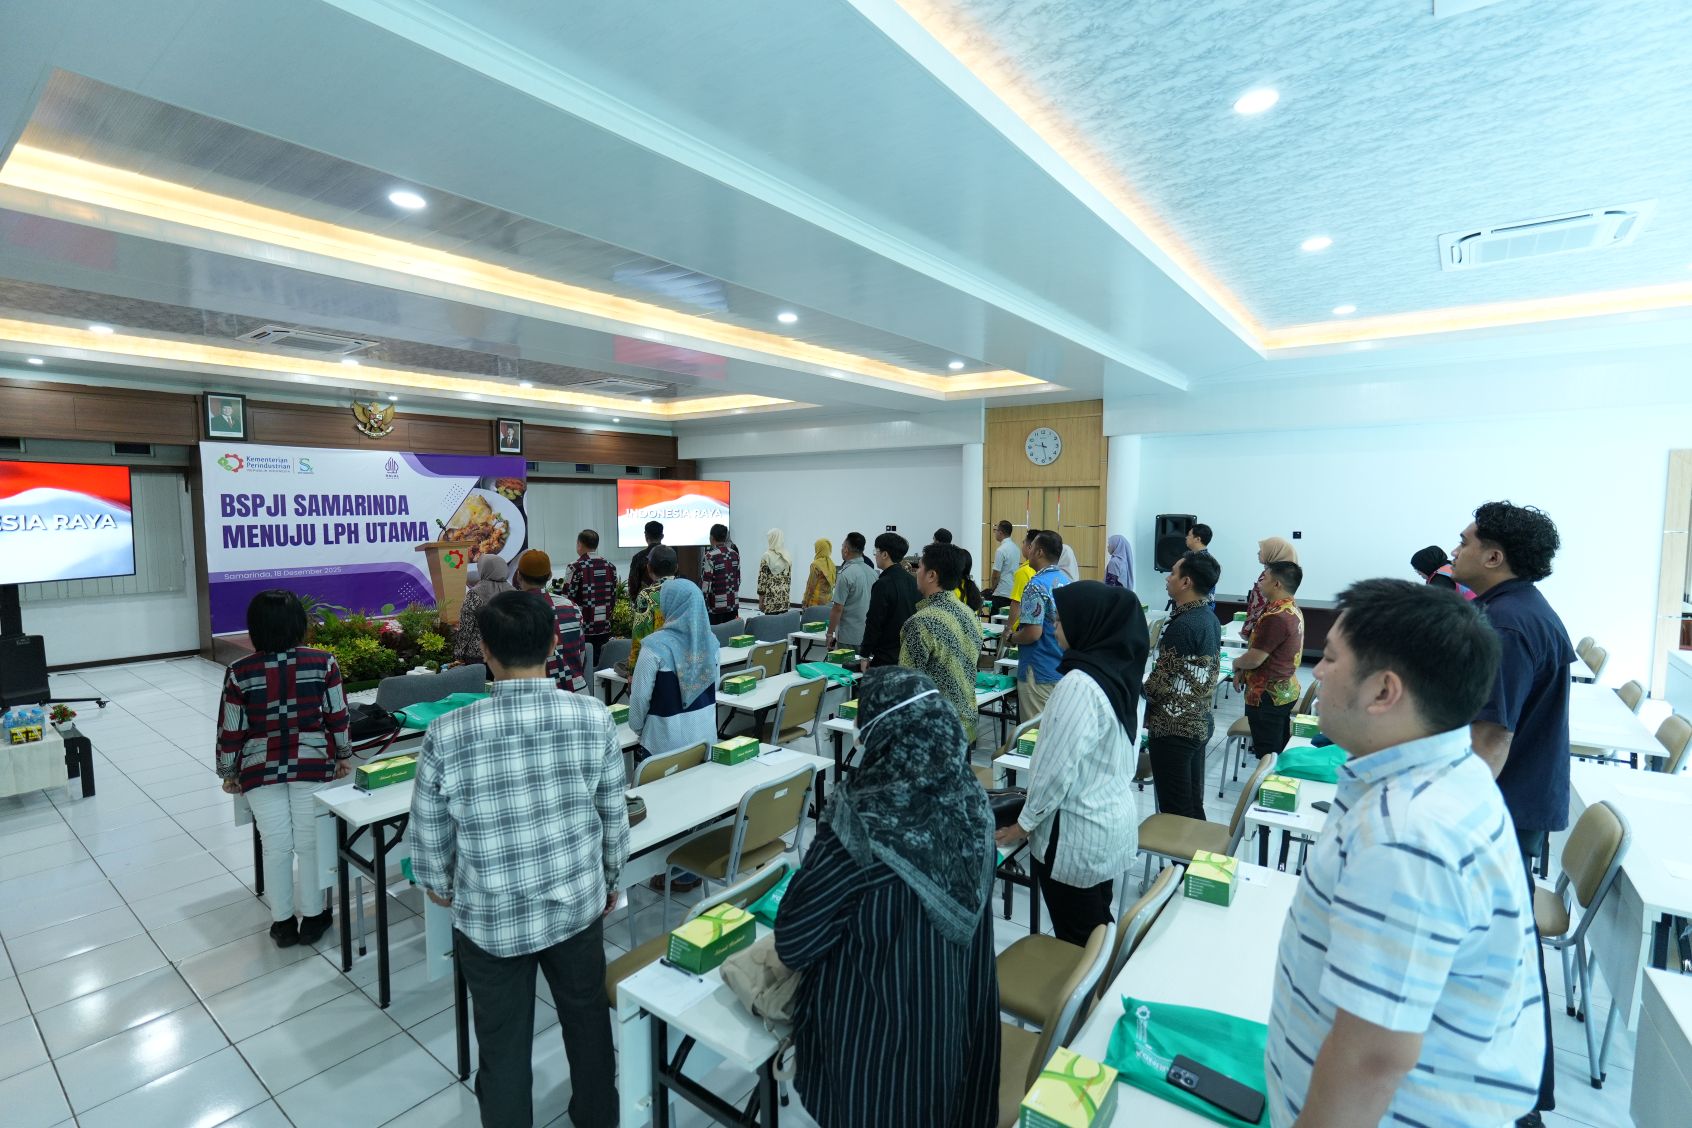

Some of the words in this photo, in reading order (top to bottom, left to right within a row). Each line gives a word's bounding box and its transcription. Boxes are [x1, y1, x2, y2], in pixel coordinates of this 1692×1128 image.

[220, 493, 287, 518] BSPJI
[293, 494, 410, 517] SAMARINDA
[626, 508, 689, 519] INDONESIA
[694, 508, 722, 519] RAYA
[0, 514, 47, 531] SIA
[54, 513, 117, 530] RAYA
[222, 524, 316, 549] MENUJU
[323, 523, 360, 545] LPH
[365, 521, 430, 543] UTAMA
[224, 571, 273, 580] Samarinda,
